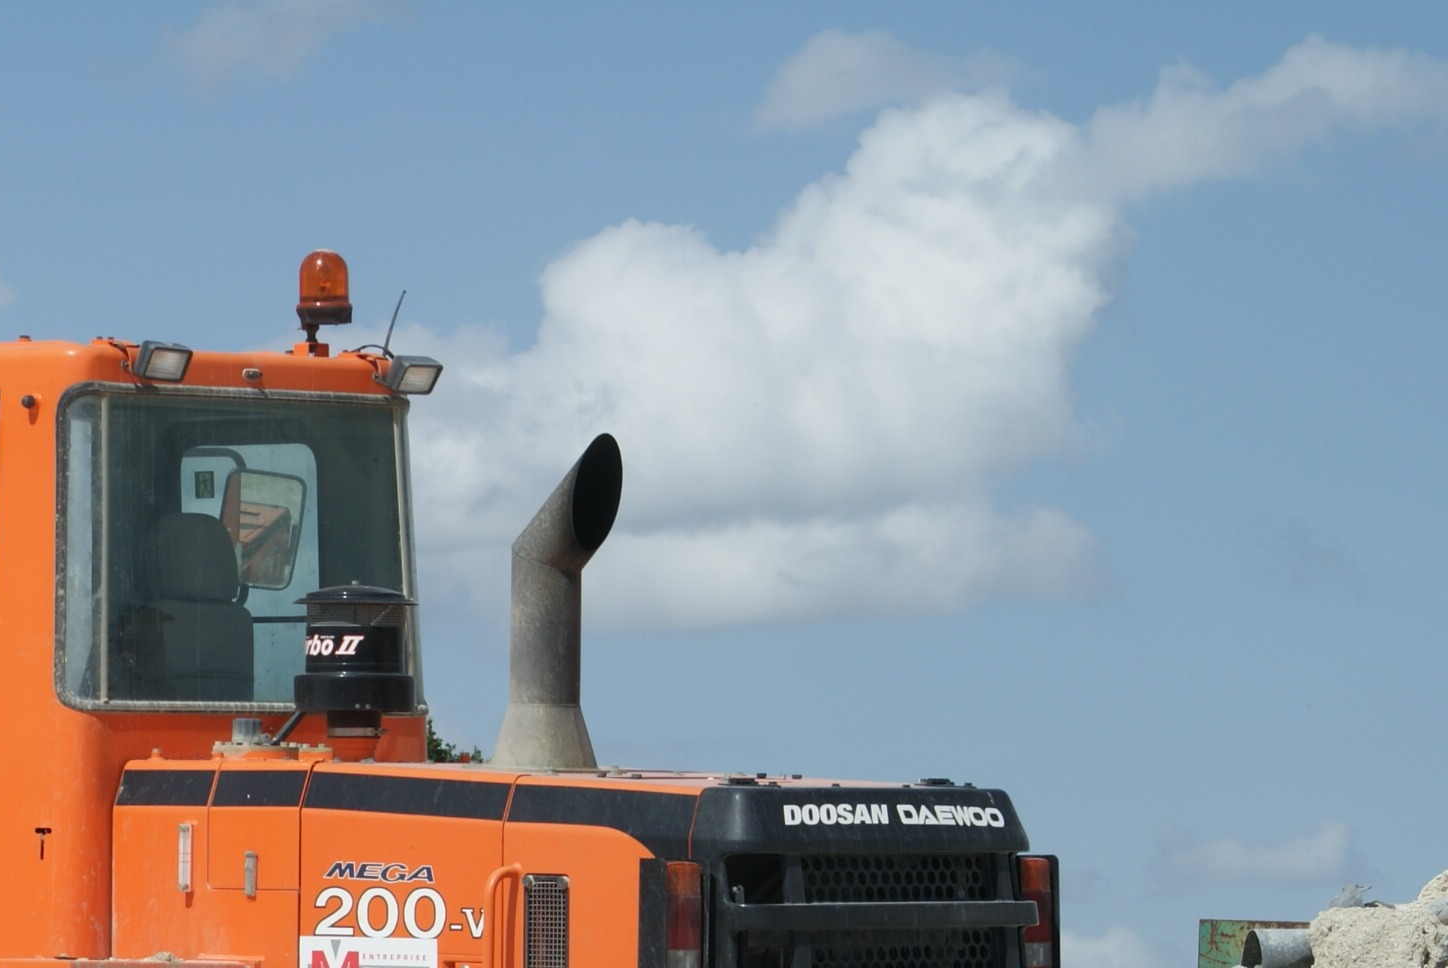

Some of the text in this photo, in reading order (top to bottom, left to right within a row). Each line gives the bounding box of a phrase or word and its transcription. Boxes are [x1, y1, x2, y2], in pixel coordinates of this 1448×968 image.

[335, 634, 365, 655] II
[783, 803, 1006, 828] DOOSAN DAEWOO
[324, 861, 435, 884] MEGA
[362, 953, 427, 961] ENTREPRISE
